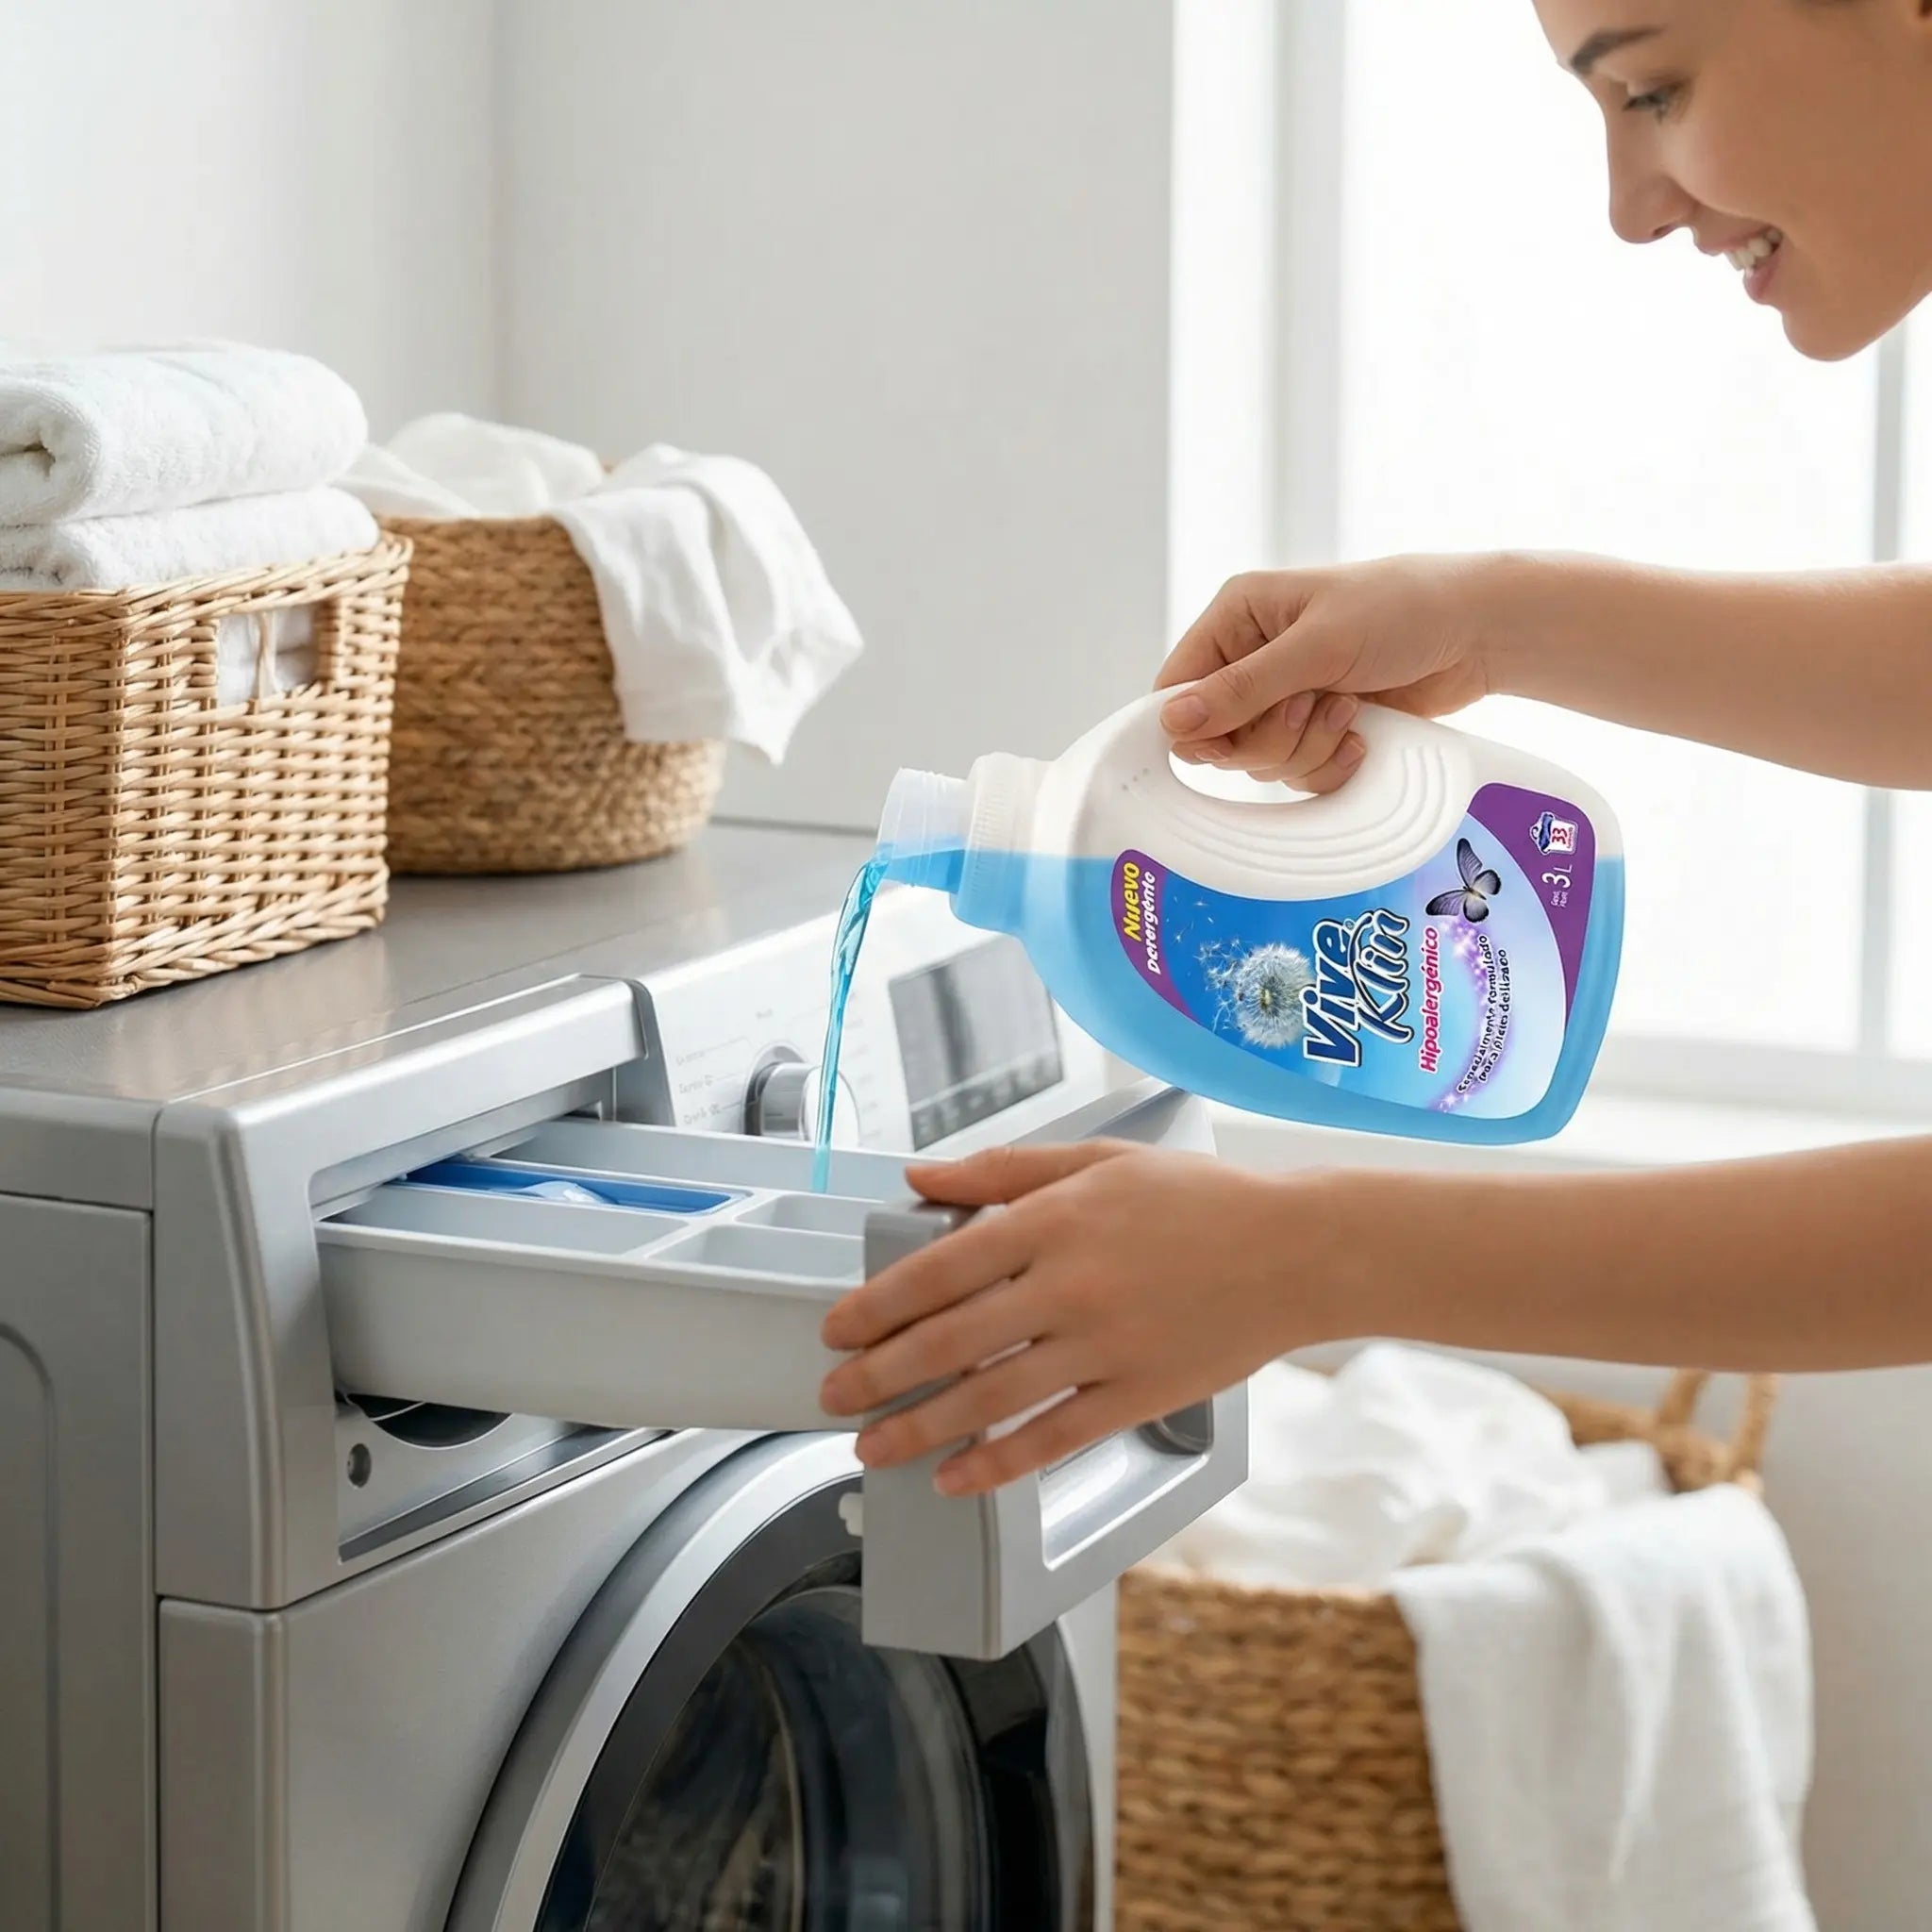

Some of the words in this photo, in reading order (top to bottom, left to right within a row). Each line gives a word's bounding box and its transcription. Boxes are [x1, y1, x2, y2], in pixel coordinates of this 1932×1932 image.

[1551, 827, 1568, 845] 33
[1553, 864, 1573, 874] L
[1123, 862, 1142, 941] Nuevo
[1541, 873, 1571, 889] 3
[1300, 920, 1360, 1066] Vive
[1350, 908, 1413, 1042] Klin
[1420, 927, 1442, 1073] Hipoalergénico
